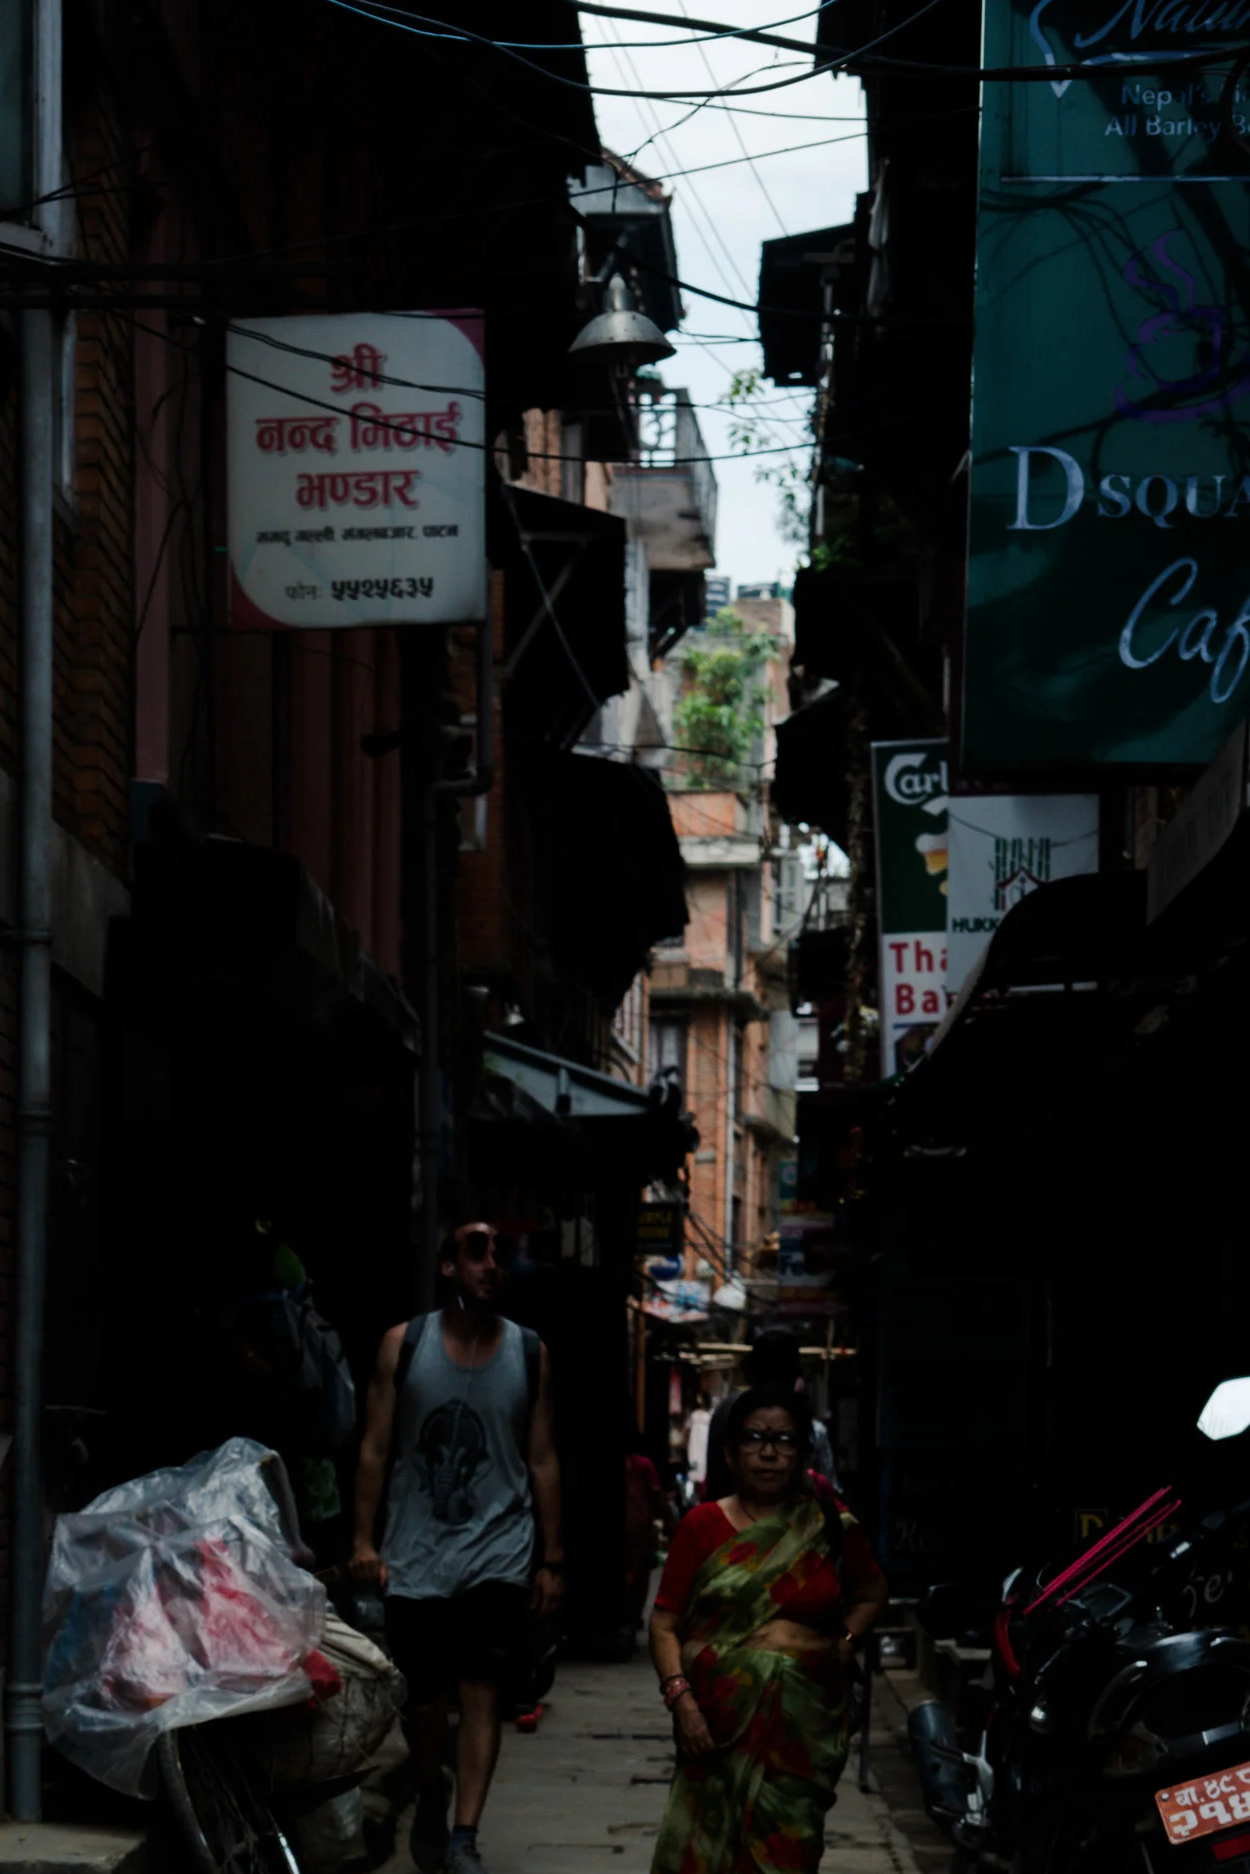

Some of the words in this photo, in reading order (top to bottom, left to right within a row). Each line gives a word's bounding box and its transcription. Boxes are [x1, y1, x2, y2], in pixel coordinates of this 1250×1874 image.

[1105, 112, 1138, 136] All
[1146, 113, 1222, 143] Barley
[331, 343, 383, 393] श्री
[256, 416, 339, 452] नन्द
[350, 401, 461, 452] मिठाई
[296, 470, 420, 508] भण्डार
[896, 984, 956, 1015] Ba
